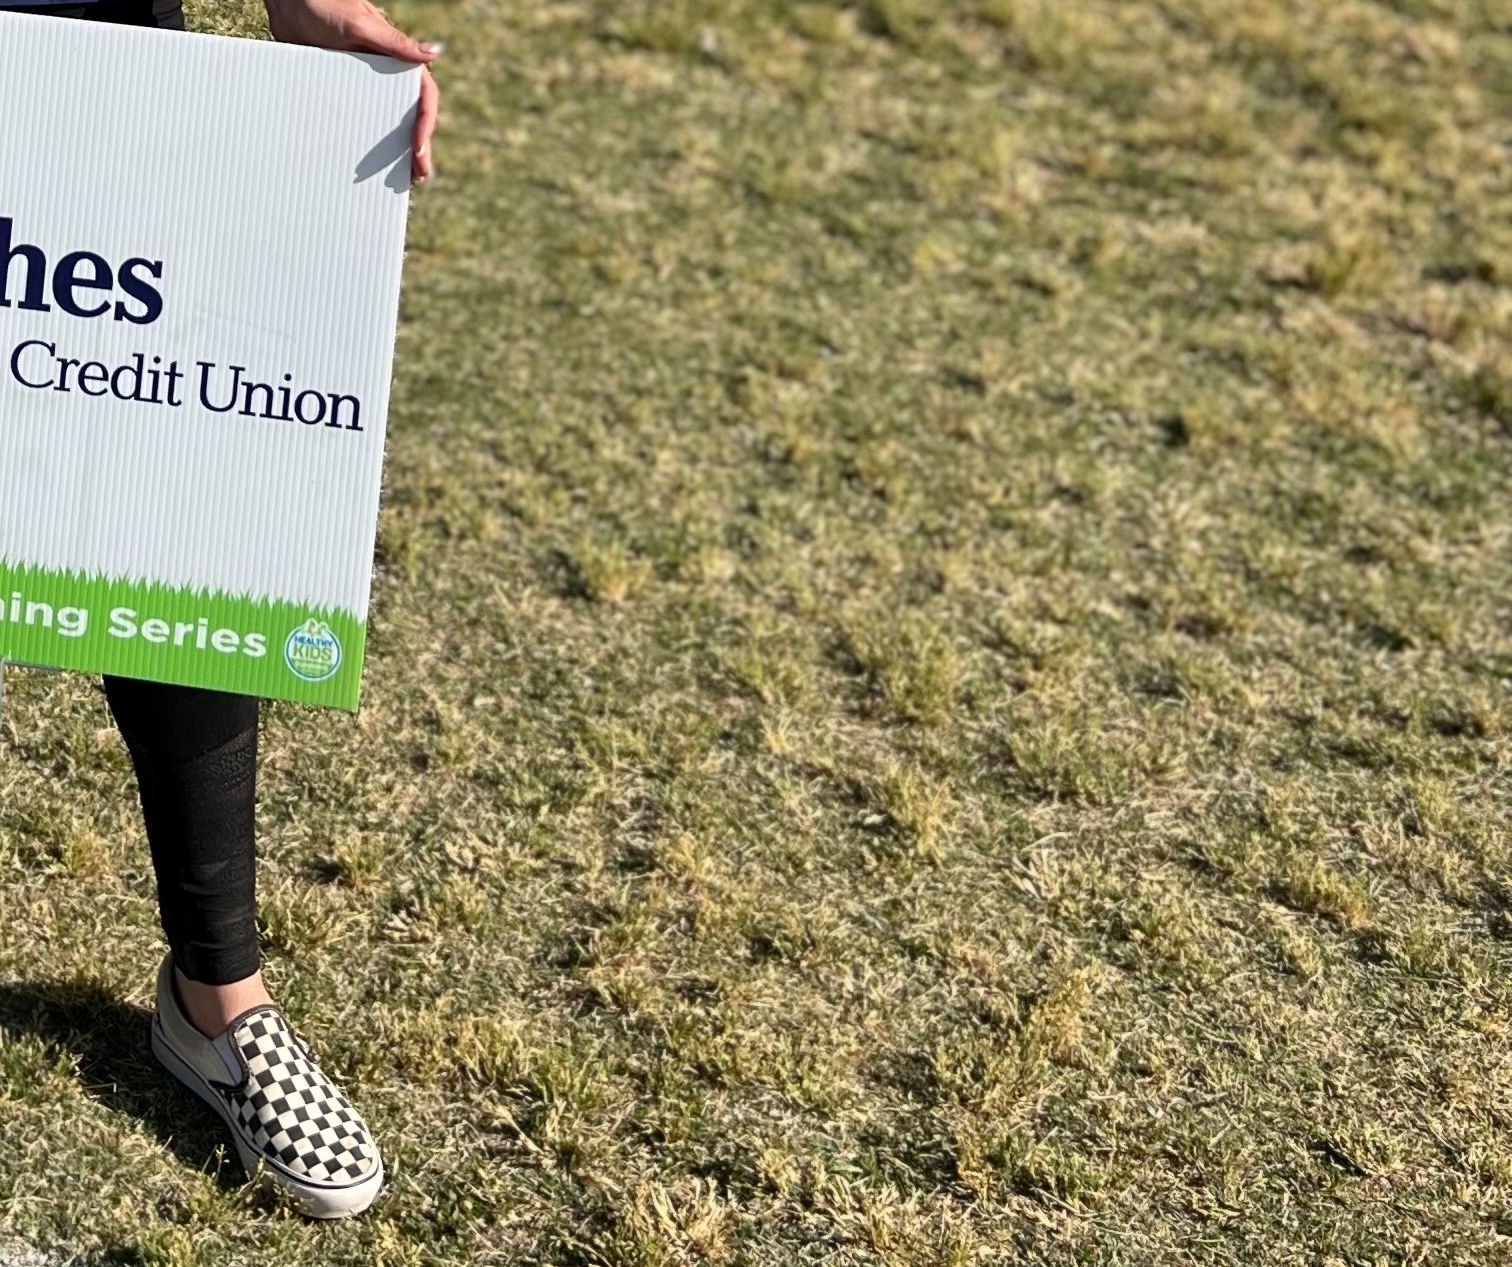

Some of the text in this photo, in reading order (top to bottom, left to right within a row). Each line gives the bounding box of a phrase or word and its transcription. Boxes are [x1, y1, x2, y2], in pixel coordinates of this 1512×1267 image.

[9, 339, 184, 407] Credit
[196, 361, 364, 432] Union
[107, 606, 267, 658] Series
[292, 643, 333, 662] KIDS
